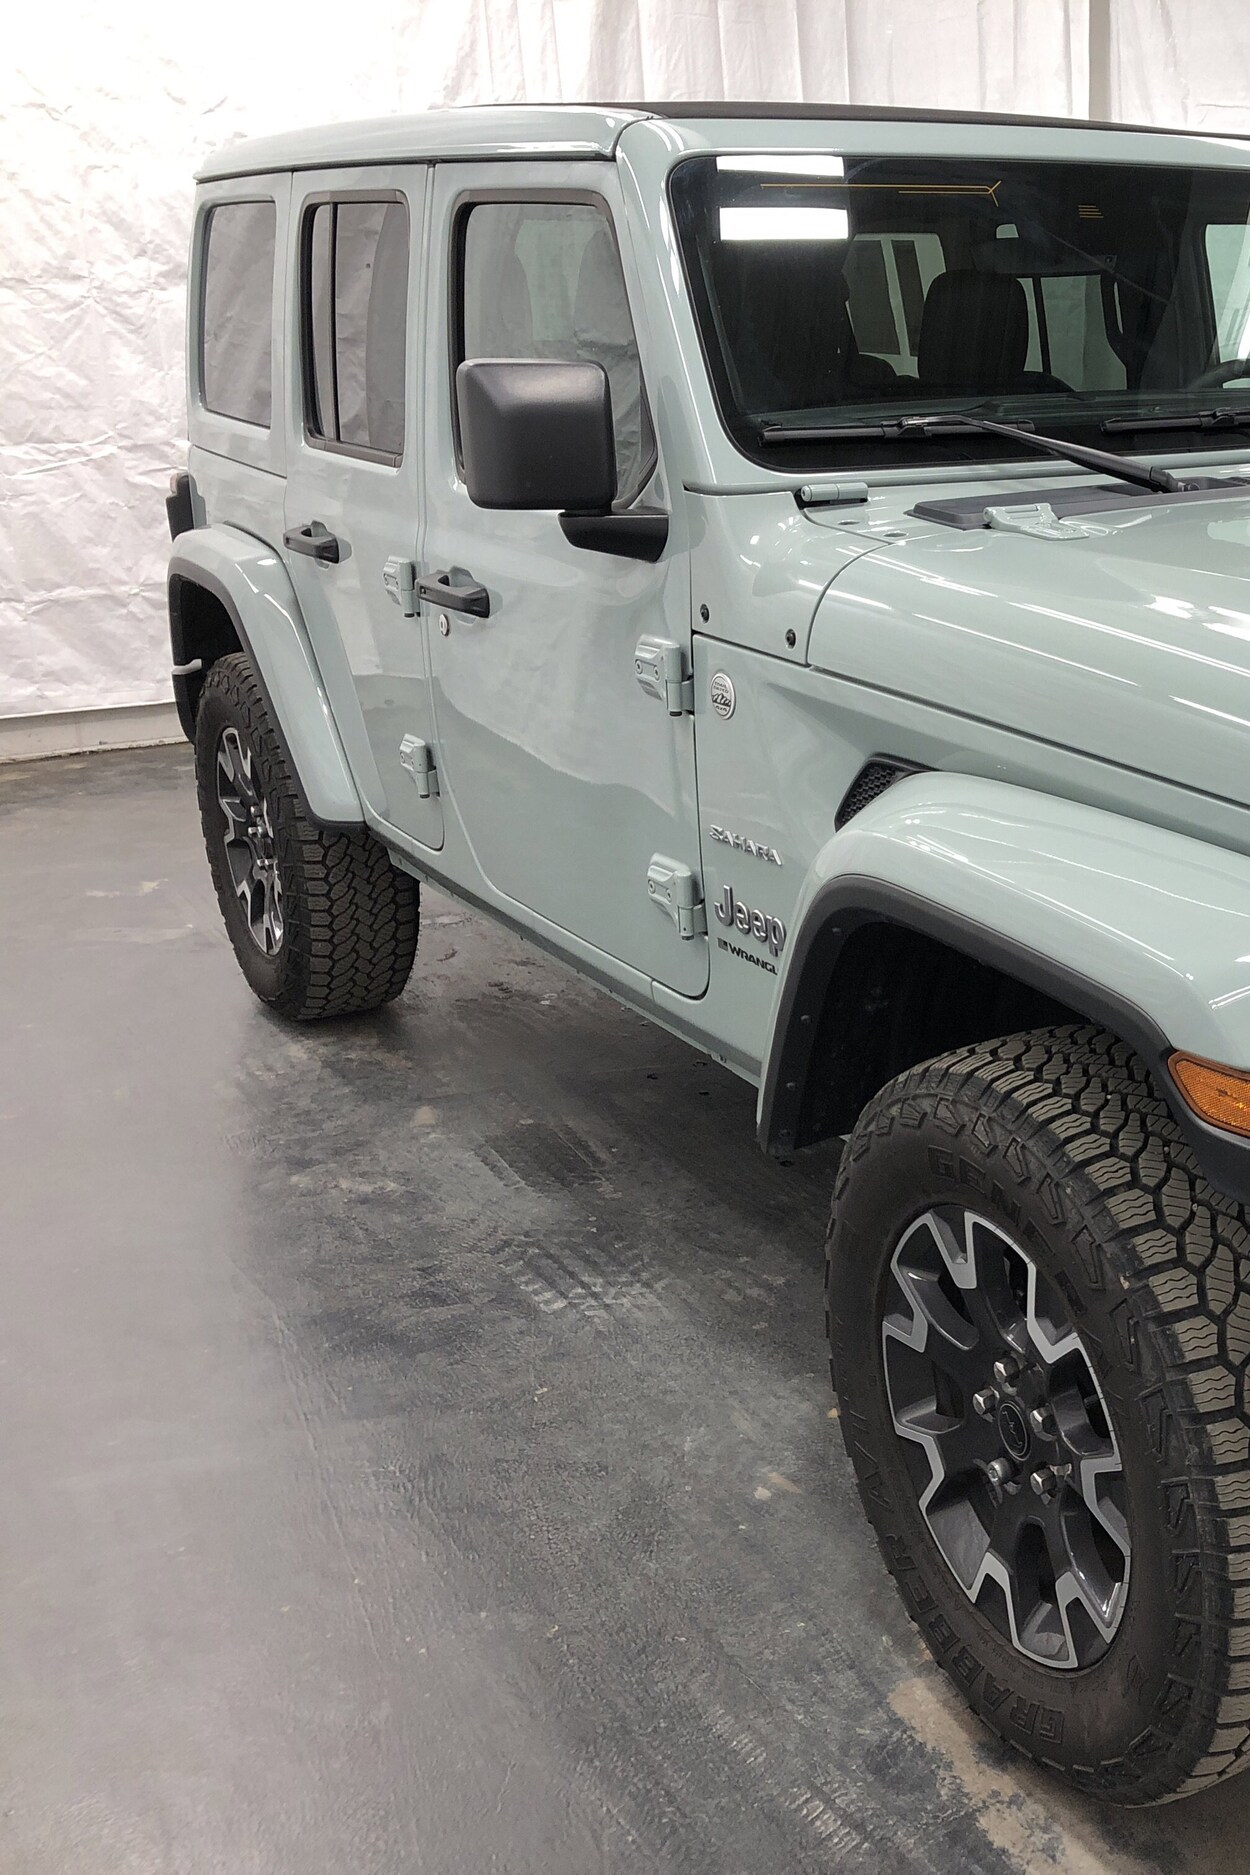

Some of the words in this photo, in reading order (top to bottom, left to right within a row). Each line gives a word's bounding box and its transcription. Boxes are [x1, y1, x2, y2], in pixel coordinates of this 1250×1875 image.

[709, 824, 783, 866] SAHARA
[714, 885, 787, 958] Jeep
[728, 942, 779, 976] WRANGL
[886, 1532, 1066, 1745] GRABBER
